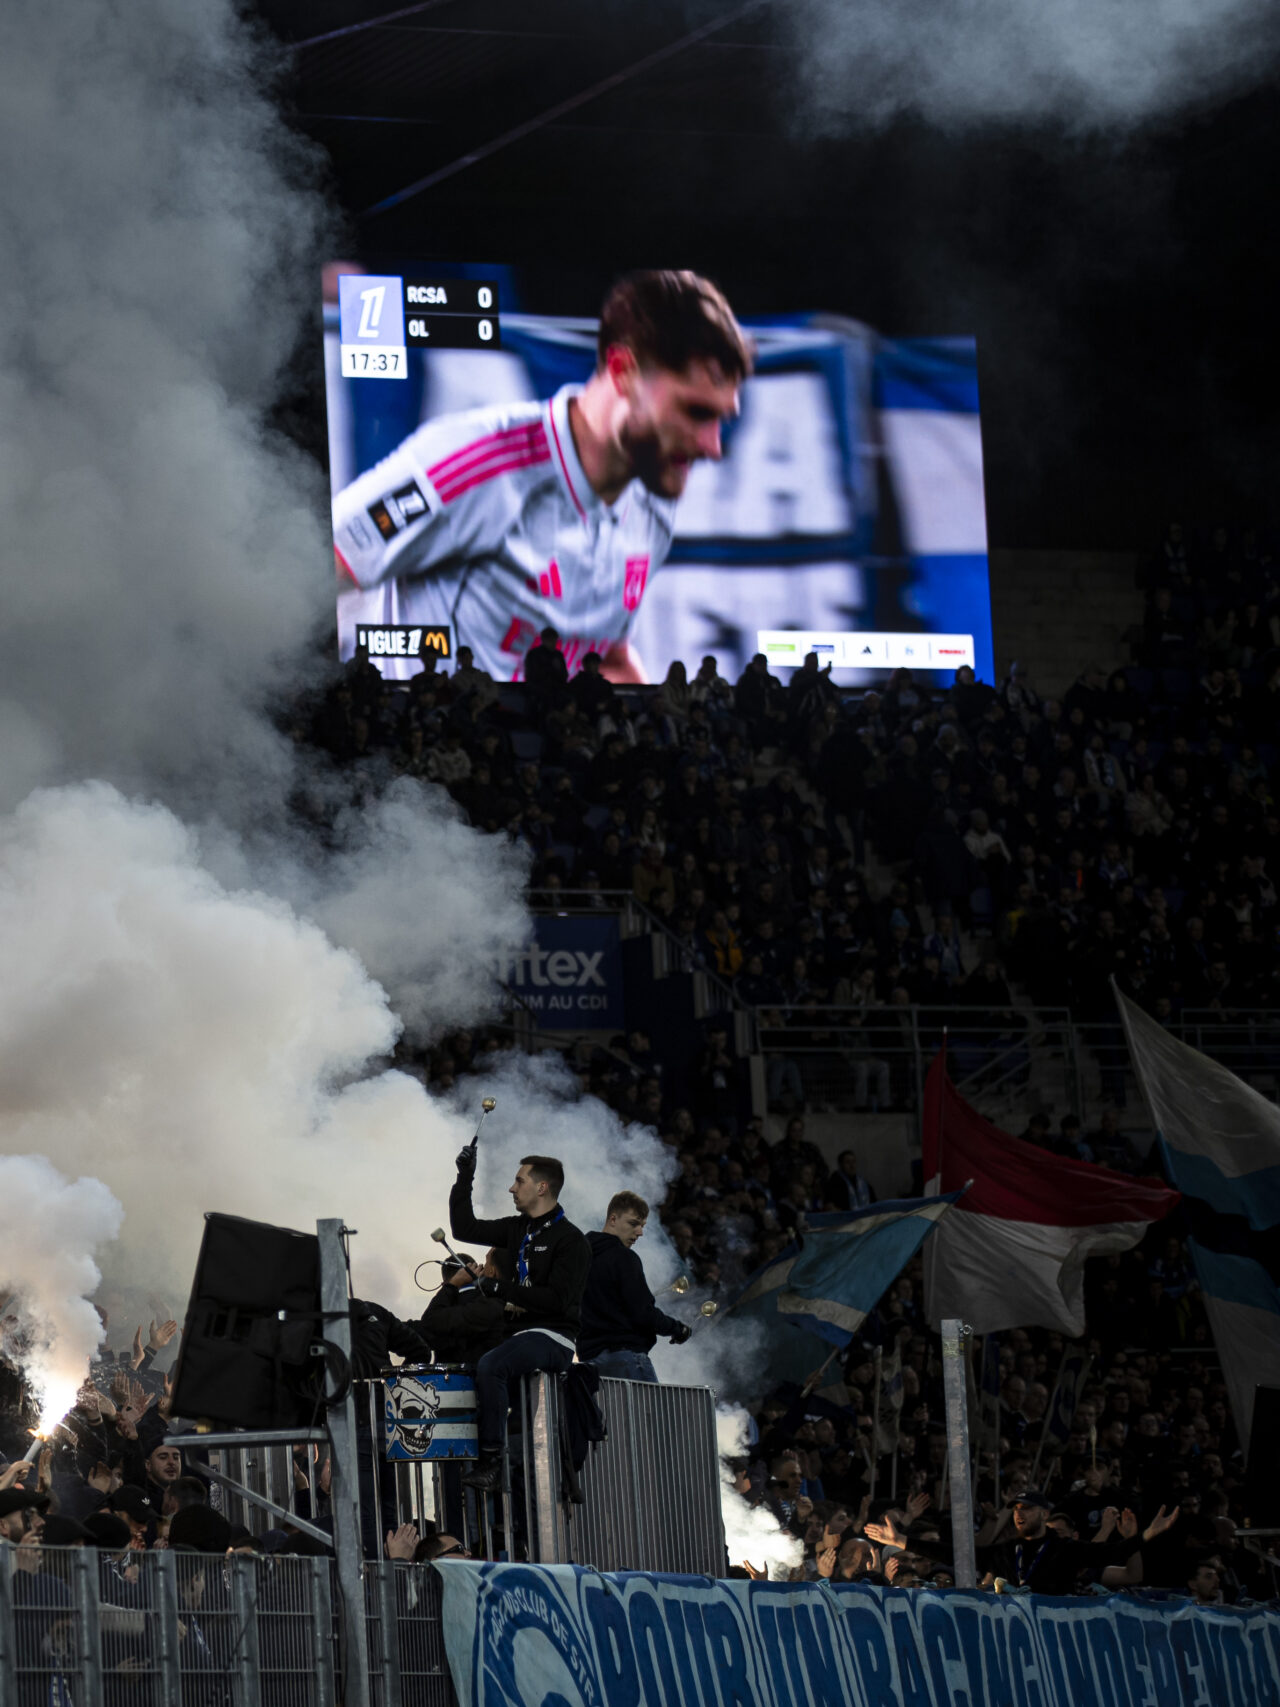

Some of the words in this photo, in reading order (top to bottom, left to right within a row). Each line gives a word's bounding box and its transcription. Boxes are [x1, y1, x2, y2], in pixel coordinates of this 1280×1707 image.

[407, 286, 448, 304] RCSA
[477, 287, 493, 309] 0
[408, 319, 430, 338] OL
[478, 319, 494, 341] 0
[350, 353, 400, 371] 17:37
[547, 995, 573, 1010] AU
[576, 994, 609, 1010] CDI
[551, 1609, 568, 1652] DE
[570, 1644, 597, 1707] STR
[1036, 1608, 1280, 1707] INDEPENDA
